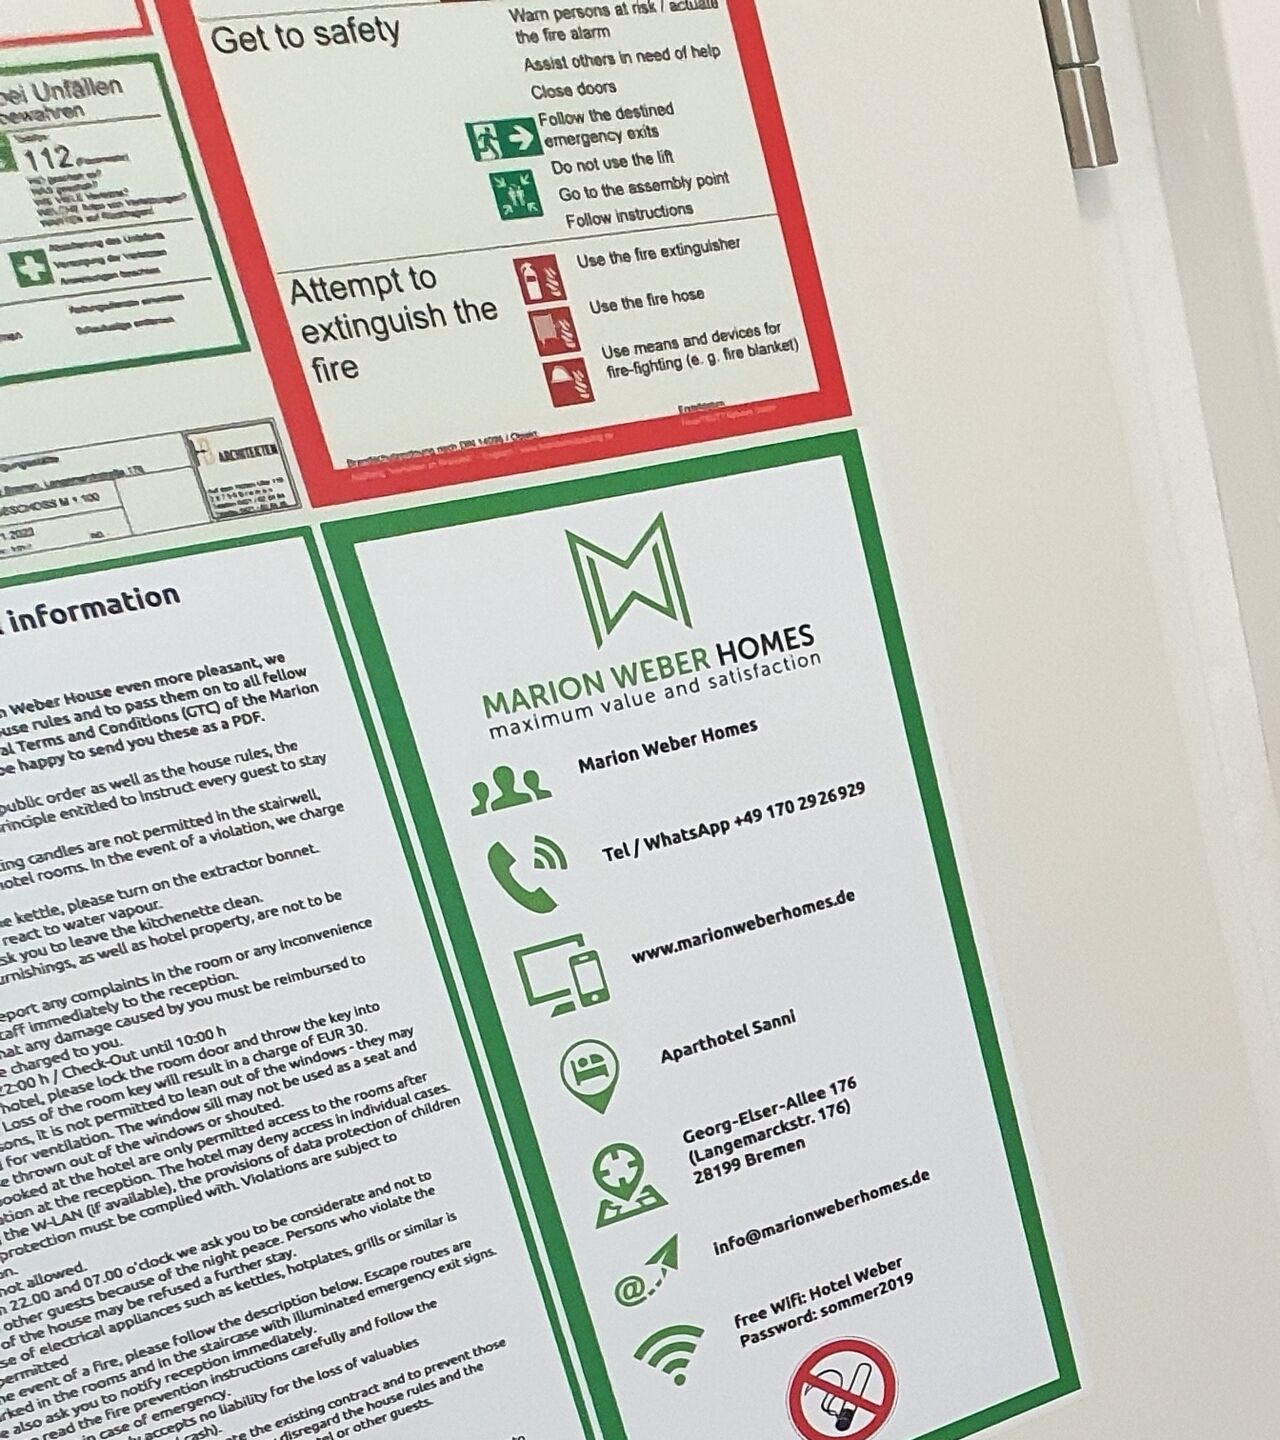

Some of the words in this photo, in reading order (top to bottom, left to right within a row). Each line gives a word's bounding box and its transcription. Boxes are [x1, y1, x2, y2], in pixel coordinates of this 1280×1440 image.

[507, 7, 549, 23] Warn
[552, 5, 611, 23] persons
[613, 1, 629, 16] at
[631, 0, 657, 14] risk
[660, 0, 664, 12] /
[210, 24, 270, 54] Get
[274, 23, 304, 49] to
[313, 15, 399, 48] safety
[514, 29, 539, 44] the
[541, 27, 566, 42] fire
[569, 25, 610, 40] alarm
[524, 55, 569, 72] Assist
[571, 53, 616, 68] others
[617, 50, 633, 64] in
[635, 47, 671, 63] need
[673, 44, 687, 60] of
[689, 43, 721, 60] help
[32, 77, 124, 102] Unfällen
[530, 84, 573, 100] Close
[576, 81, 617, 96] doors
[537, 110, 585, 126] Follow
[587, 108, 612, 122] the
[615, 100, 674, 120] destined
[543, 130, 622, 148] emergency
[626, 123, 659, 140] exits
[24, 144, 74, 171] 112
[550, 159, 572, 175] Do
[575, 157, 600, 172] not
[601, 157, 628, 170] use
[630, 152, 654, 167] the
[656, 149, 675, 163] lift
[558, 187, 581, 202] Go
[582, 185, 598, 198] to
[600, 183, 625, 197] the
[627, 175, 692, 194] assembly
[695, 170, 730, 190] point
[564, 211, 611, 228] Follow
[614, 203, 694, 223] instructions
[575, 253, 606, 268] Use
[608, 250, 631, 265] the
[633, 246, 657, 261] fire
[660, 237, 740, 258] extinguisher
[290, 267, 404, 306] Attempt
[408, 266, 437, 290] to
[588, 299, 618, 314] Use
[620, 295, 643, 310] the
[645, 292, 668, 306] fire
[670, 288, 705, 303] hose
[301, 302, 447, 344] extinguish
[452, 297, 498, 324] the
[600, 344, 630, 359] Use
[633, 338, 679, 355] means
[682, 331, 708, 347] and
[710, 325, 761, 343] devices
[763, 321, 781, 335] for
[311, 356, 359, 383] fire
[605, 356, 683, 378] fire-fighting
[722, 346, 744, 360] fire
[746, 336, 799, 357] blanket)
[5, 586, 180, 632] information
[7, 697, 60, 715] Weber
[63, 687, 112, 705] House
[115, 680, 152, 695] even
[153, 671, 193, 687] more
[195, 657, 263, 681] pleasant,
[263, 653, 285, 665] we
[481, 669, 605, 719] MARION
[609, 647, 711, 689] WEBER
[714, 623, 815, 666] HOMES
[488, 705, 594, 740] maximum
[599, 690, 656, 713] value
[663, 676, 700, 699] and
[707, 652, 821, 689] satisfaction
[577, 748, 640, 773] Marion
[640, 733, 697, 757] Weber
[700, 719, 758, 743] Homes
[601, 841, 631, 862] Tel
[633, 837, 639, 858] /
[642, 819, 730, 851] WhatsApp
[733, 807, 762, 826] +49
[765, 799, 795, 818] 170
[630, 889, 855, 964] www.marionweberhomes.de
[660, 1022, 750, 1064] Aparthotel
[751, 1008, 796, 1034] Sanni
[1, 1115, 36, 1132] Loss
[38, 1106, 53, 1122] of
[56, 1102, 83, 1116] the
[85, 1091, 125, 1109] room
[125, 1083, 151, 1097] key
[153, 1072, 180, 1089] will
[181, 1061, 224, 1082] result
[223, 1058, 239, 1070] in
[241, 1056, 250, 1065] a
[252, 1042, 298, 1062] charge
[300, 1033, 313, 1049] of
[315, 1027, 345, 1044] EUR
[345, 1021, 367, 1036] 30.
[682, 1088, 826, 1143] Georg-Elser-Allee
[829, 1075, 857, 1095] 176
[688, 1114, 815, 1166] (Langemarckstr.
[817, 1097, 850, 1120] 176)
[692, 1157, 741, 1184] 28199
[744, 1138, 806, 1167] Bremen
[712, 1169, 930, 1255] info@marionweberhomes.de
[733, 1308, 767, 1329] free
[769, 1291, 807, 1314] Wifi:
[808, 1272, 852, 1301] Hotel
[853, 1257, 902, 1283] Weber
[739, 1308, 818, 1348] Password:
[819, 1271, 913, 1317] sommer2019
